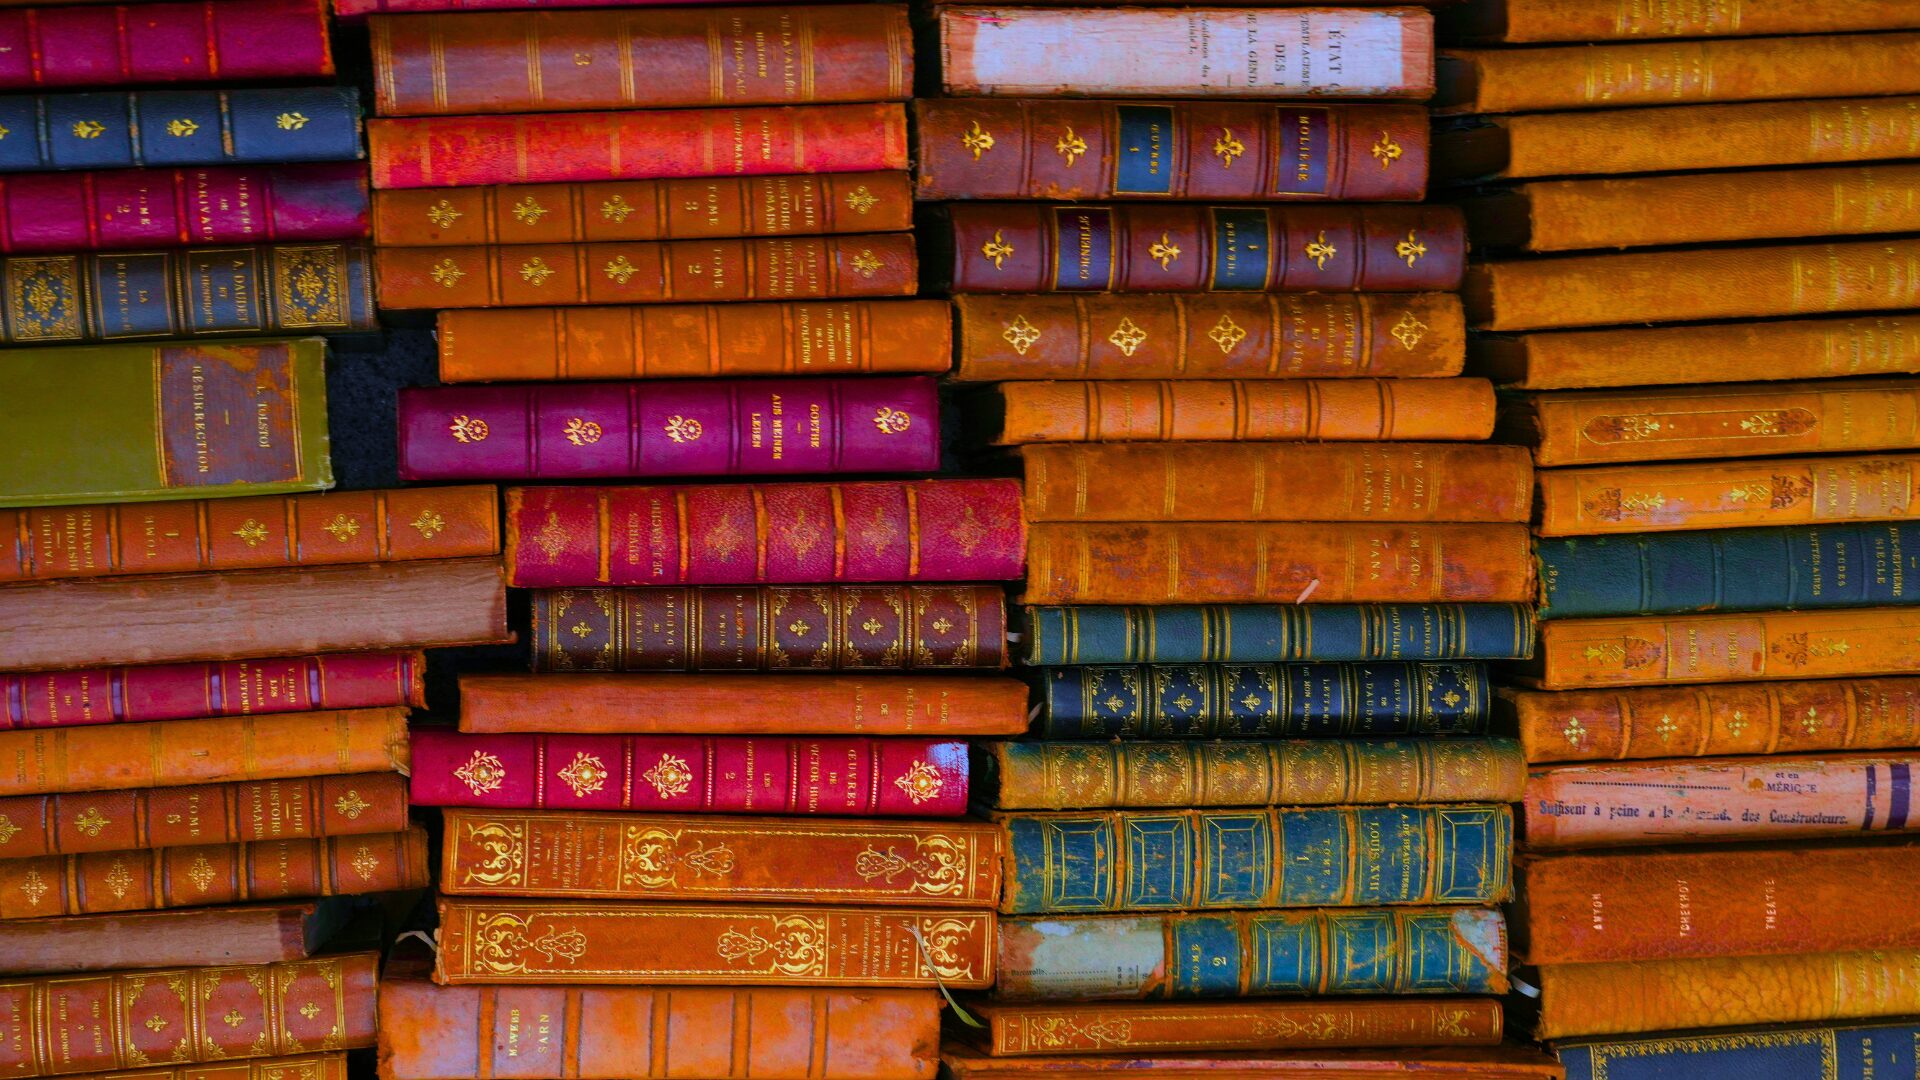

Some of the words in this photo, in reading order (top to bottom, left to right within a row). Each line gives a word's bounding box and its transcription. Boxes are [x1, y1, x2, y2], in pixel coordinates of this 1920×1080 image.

[1247, 29, 1258, 46] LA
[1328, 30, 1347, 75] ÉTAT
[1275, 43, 1288, 71] DES
[772, 393, 783, 416] AUS
[751, 412, 762, 449] LEBEN
[809, 404, 821, 448] GOETHE
[1412, 477, 1425, 510] ZOLA
[1370, 539, 1382, 581] NANA
[1303, 679, 1312, 698] MON
[880, 703, 889, 716] DE
[940, 703, 948, 725] GIDE
[810, 743, 820, 783] VICTOR
[829, 772, 838, 785] DE
[846, 749, 858, 807] ŒUVRES
[808, 786, 818, 813] HUGO
[1295, 855, 1311, 863] 1
[1322, 838, 1331, 877] TOME
[1369, 822, 1382, 861] LOUIS
[1369, 865, 1381, 892] XVII
[1399, 839, 1410, 900] BEAUCHESNE
[1592, 893, 1603, 931] ANTON
[1677, 880, 1690, 938] TCHEKHOV
[1764, 880, 1776, 931] THEATRE
[901, 937, 910, 978] TAINE
[538, 1013, 551, 1055] SARN
